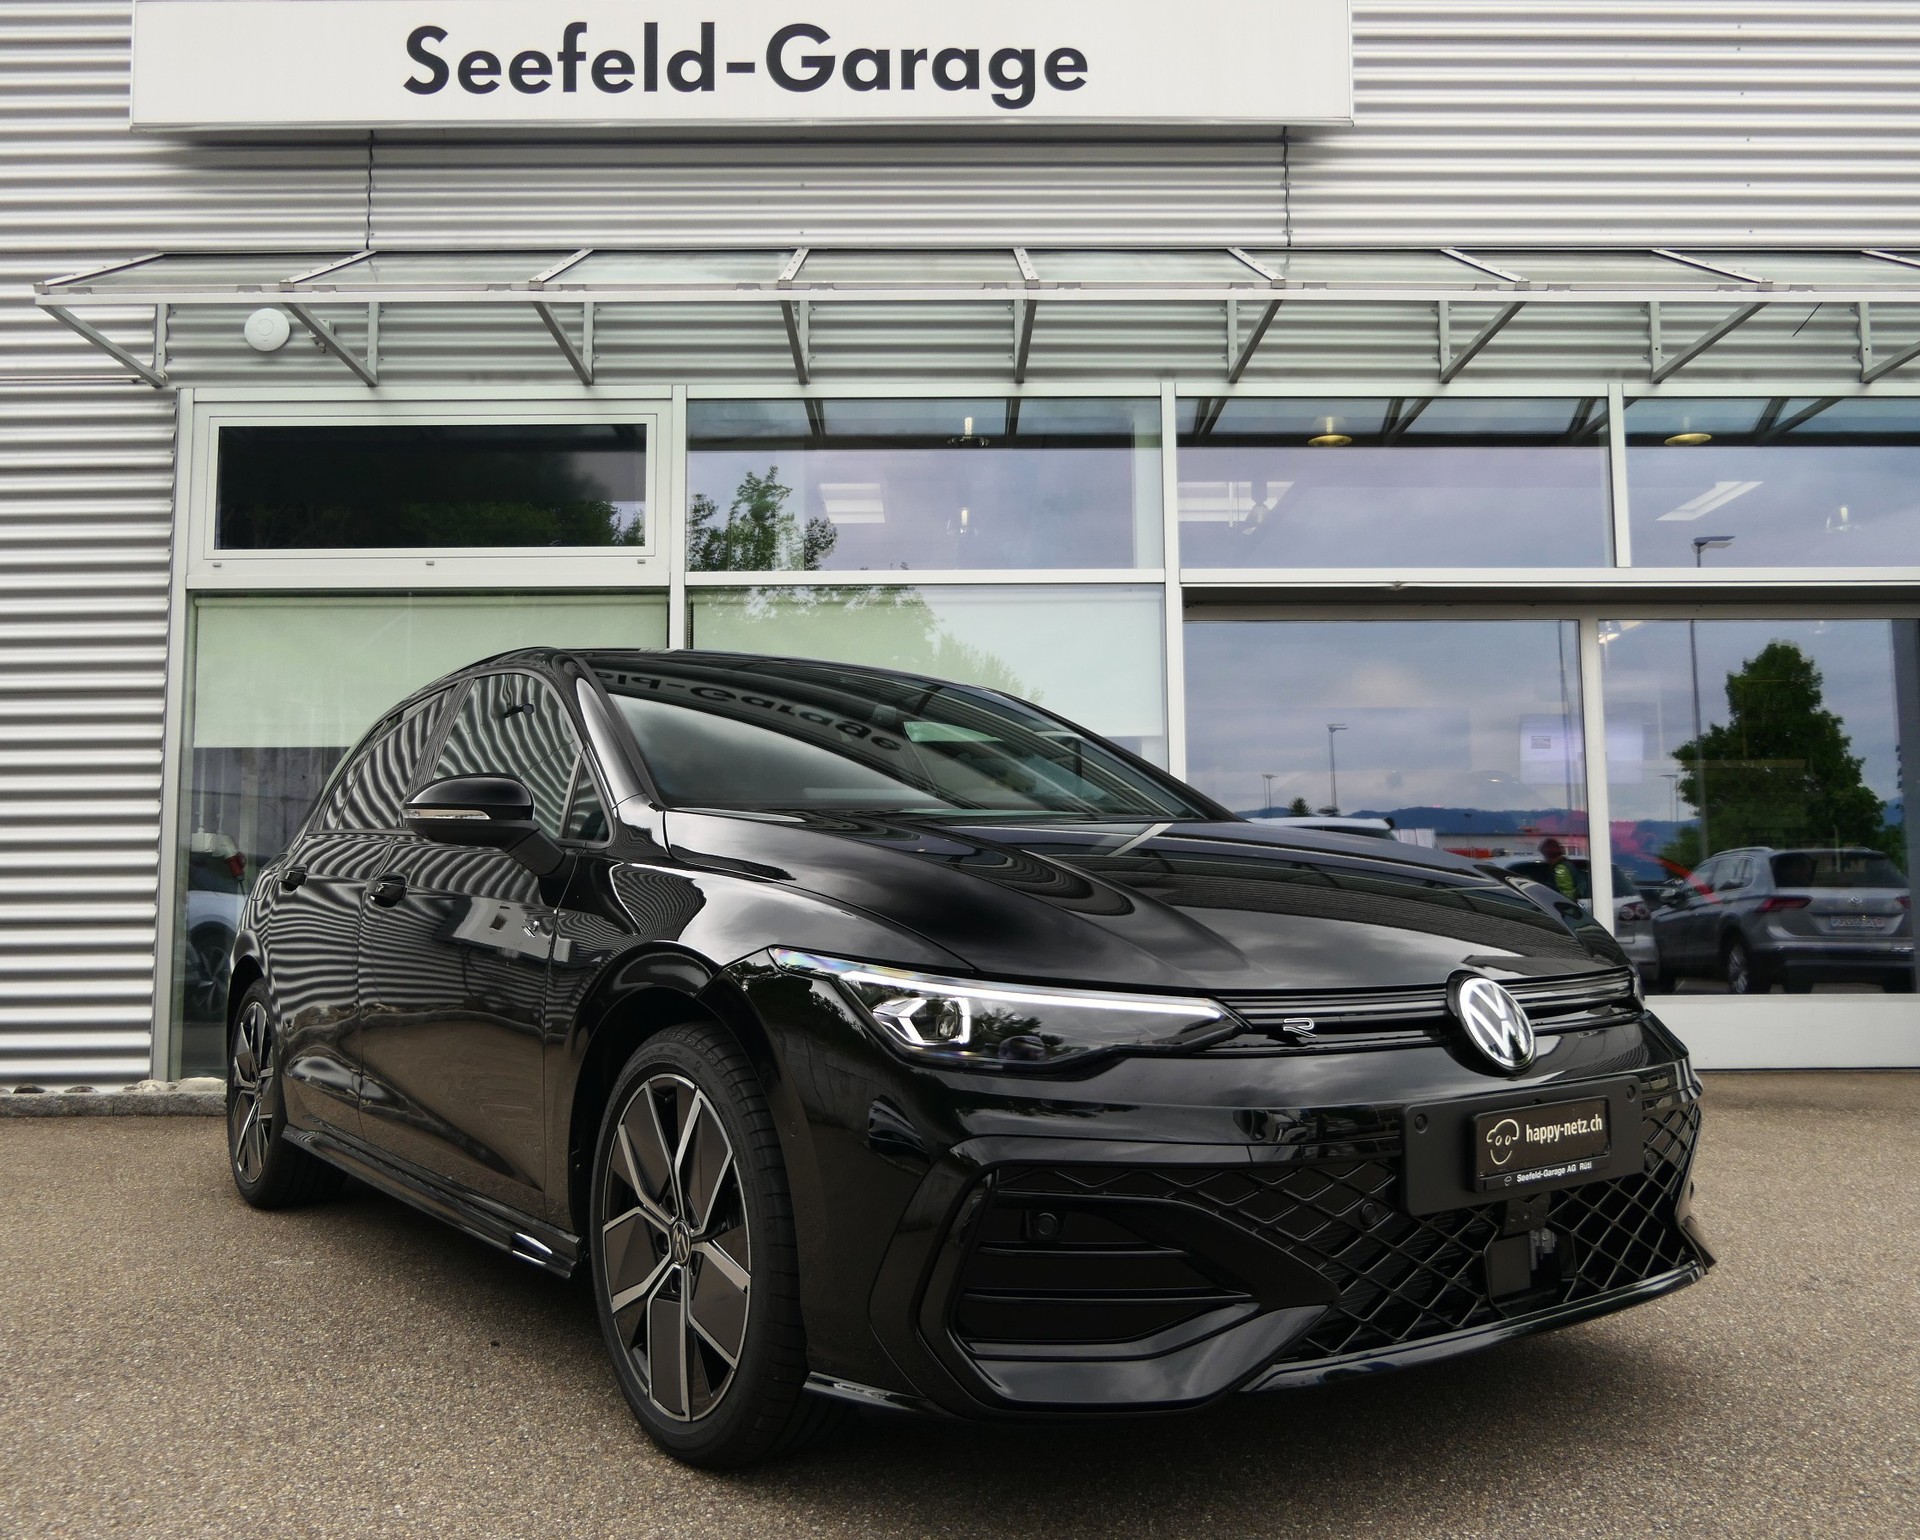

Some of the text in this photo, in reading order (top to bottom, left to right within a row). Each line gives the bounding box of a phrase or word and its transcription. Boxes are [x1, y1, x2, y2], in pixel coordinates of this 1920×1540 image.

[403, 21, 1088, 110] Seefeld-Garage
[1526, 1113, 1603, 1145] happy-netz.ch
[1516, 1166, 1566, 1183] Seefeld-Garage
[1566, 1163, 1577, 1173] AG
